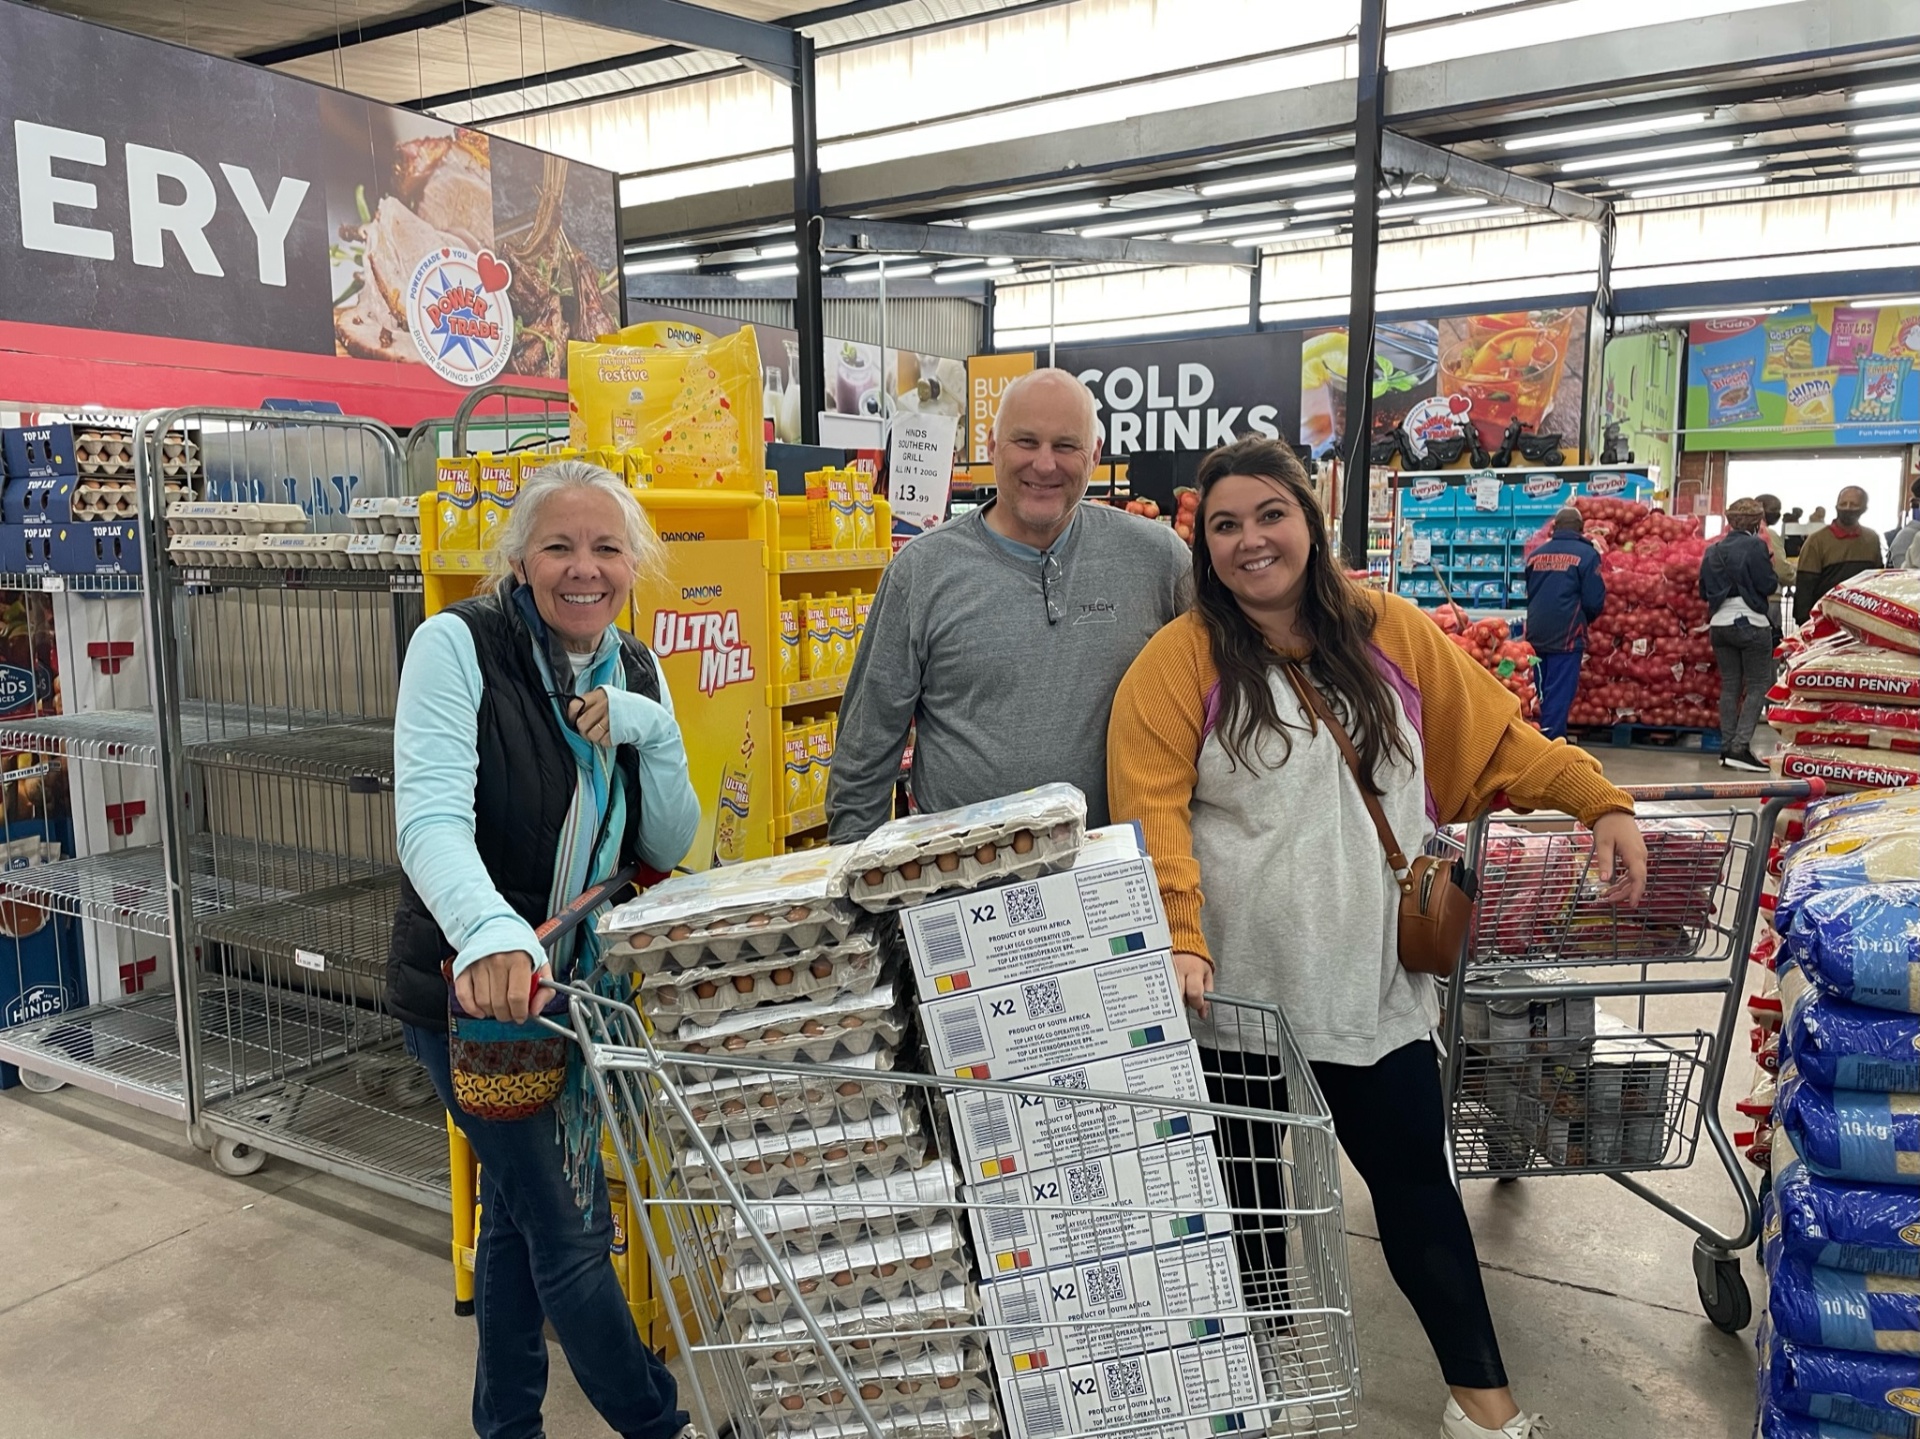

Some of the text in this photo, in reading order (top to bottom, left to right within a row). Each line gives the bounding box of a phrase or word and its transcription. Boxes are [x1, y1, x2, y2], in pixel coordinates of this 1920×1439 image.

[14, 119, 310, 287] ERY
[410, 250, 468, 300] POWERTRADE YOU
[426, 286, 488, 328] POWER
[448, 317, 499, 340] TRADE
[1836, 322, 1872, 334] STYLOS
[668, 328, 701, 344] DANONE
[414, 330, 510, 382] BIGGER SAVINGS BETTER LIVING
[598, 368, 648, 382] festive
[1077, 362, 1214, 411] COLD
[1788, 380, 1831, 402] CHIPPA
[23, 430, 50, 442] TOP LAY
[906, 429, 926, 438] HINDS
[1096, 405, 1279, 454] RINKS
[898, 441, 937, 451] SOUTHERN
[903, 453, 924, 462] GRILL
[439, 468, 468, 482] ULTRA
[482, 467, 510, 481] ULTRA
[914, 466, 917, 474] 1
[920, 469, 937, 477] 200G
[28, 480, 56, 489] TOP LAY
[455, 482, 472, 496] MEL
[497, 480, 514, 494] MEL
[830, 480, 846, 491] ULTRA
[1412, 484, 1446, 495] EveryDay
[1524, 480, 1561, 492] EveryDay
[1588, 479, 1626, 491] EveryDay
[839, 492, 852, 502] MEL
[24, 528, 52, 538] TOP LAY
[93, 526, 122, 536] TOP LAY
[662, 532, 705, 541] DANONE
[682, 585, 722, 600] DANONE
[808, 609, 824, 620] ULTRA
[830, 608, 848, 618] ULTRA
[784, 621, 797, 632] MEL
[816, 620, 828, 632] MEL
[840, 618, 853, 628] MEL
[654, 611, 738, 656] ULTRA
[700, 648, 754, 696] MEL
[1794, 675, 1911, 694] GOLDEN PENNY
[786, 740, 804, 751] ULTRA
[809, 734, 826, 746] ULTRA
[794, 750, 808, 761] MEL
[818, 744, 830, 754] MEL
[1792, 761, 1910, 788] GOLDEN PENNY
[726, 778, 747, 792] ULTRA
[736, 792, 749, 803] MEL
[970, 905, 995, 923] X2
[988, 918, 1071, 942] PRODUCT OF SOUTH AFRICA
[993, 944, 1004, 952] TOP
[1004, 942, 1014, 950] LAY
[1014, 940, 1025, 948] EGG
[1061, 929, 1072, 937] LTD.
[997, 957, 1008, 965] TOP
[1062, 942, 1075, 950] BPK.
[13, 997, 60, 1022] HINDS
[990, 999, 1015, 1016] X2
[1007, 1024, 1036, 1035] PRODUCT
[1046, 1017, 1067, 1027] SOUTH
[1068, 1012, 1091, 1022] AFRICA
[1013, 1037, 1023, 1045] TOP
[1023, 1035, 1034, 1043] LAY
[1082, 1035, 1094, 1043] BPK.
[1843, 1122, 1888, 1140] 10 kg
[1033, 1182, 1058, 1200] X2
[1051, 1283, 1075, 1301] X2
[1824, 1300, 1866, 1320] 10 kg
[1071, 1378, 1096, 1395] X2
